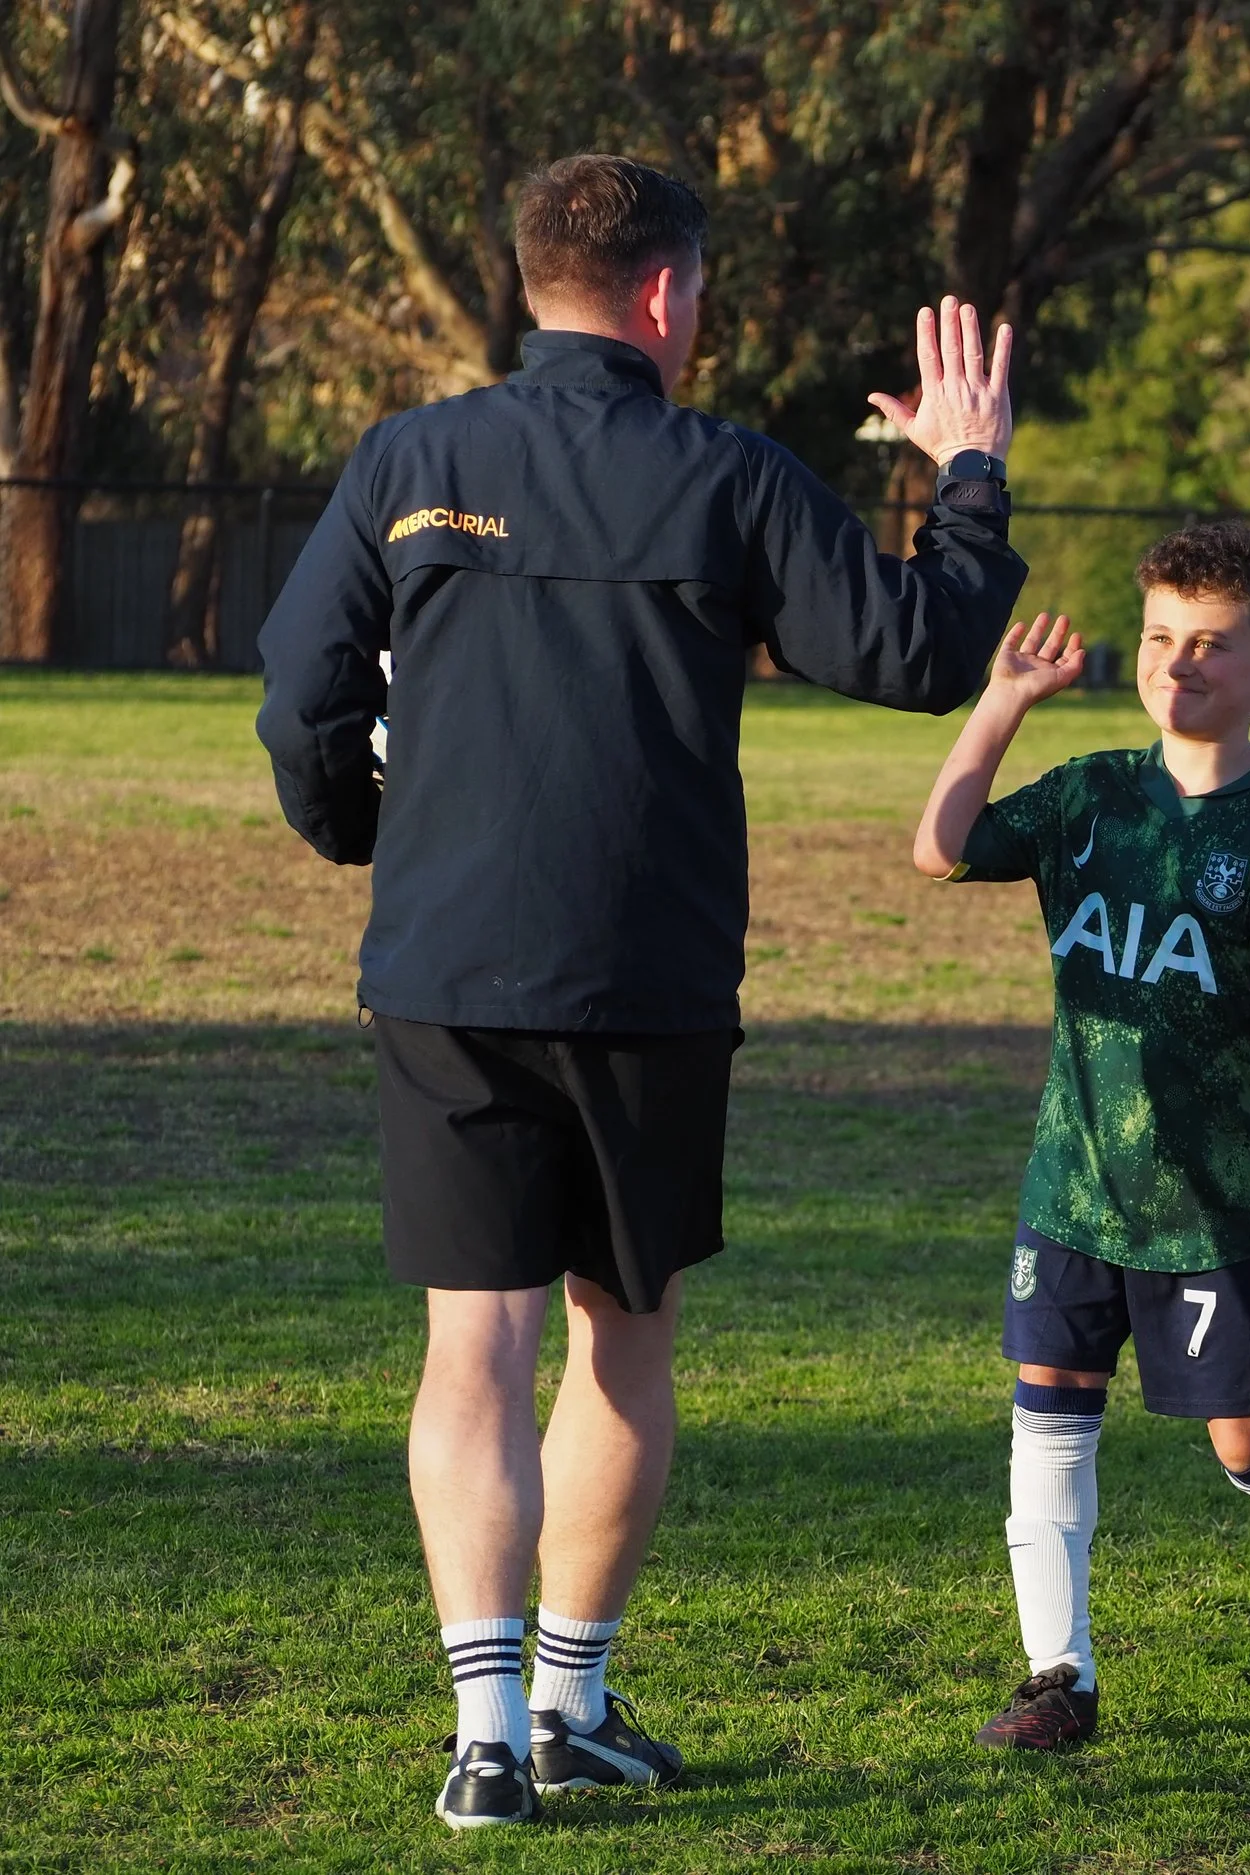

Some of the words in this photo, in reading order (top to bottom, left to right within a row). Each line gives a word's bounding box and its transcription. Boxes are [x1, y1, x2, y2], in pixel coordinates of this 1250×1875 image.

[387, 507, 510, 542] MERCURIAL
[1050, 891, 1218, 995] AIA
[1183, 1288, 1217, 1358] 7
